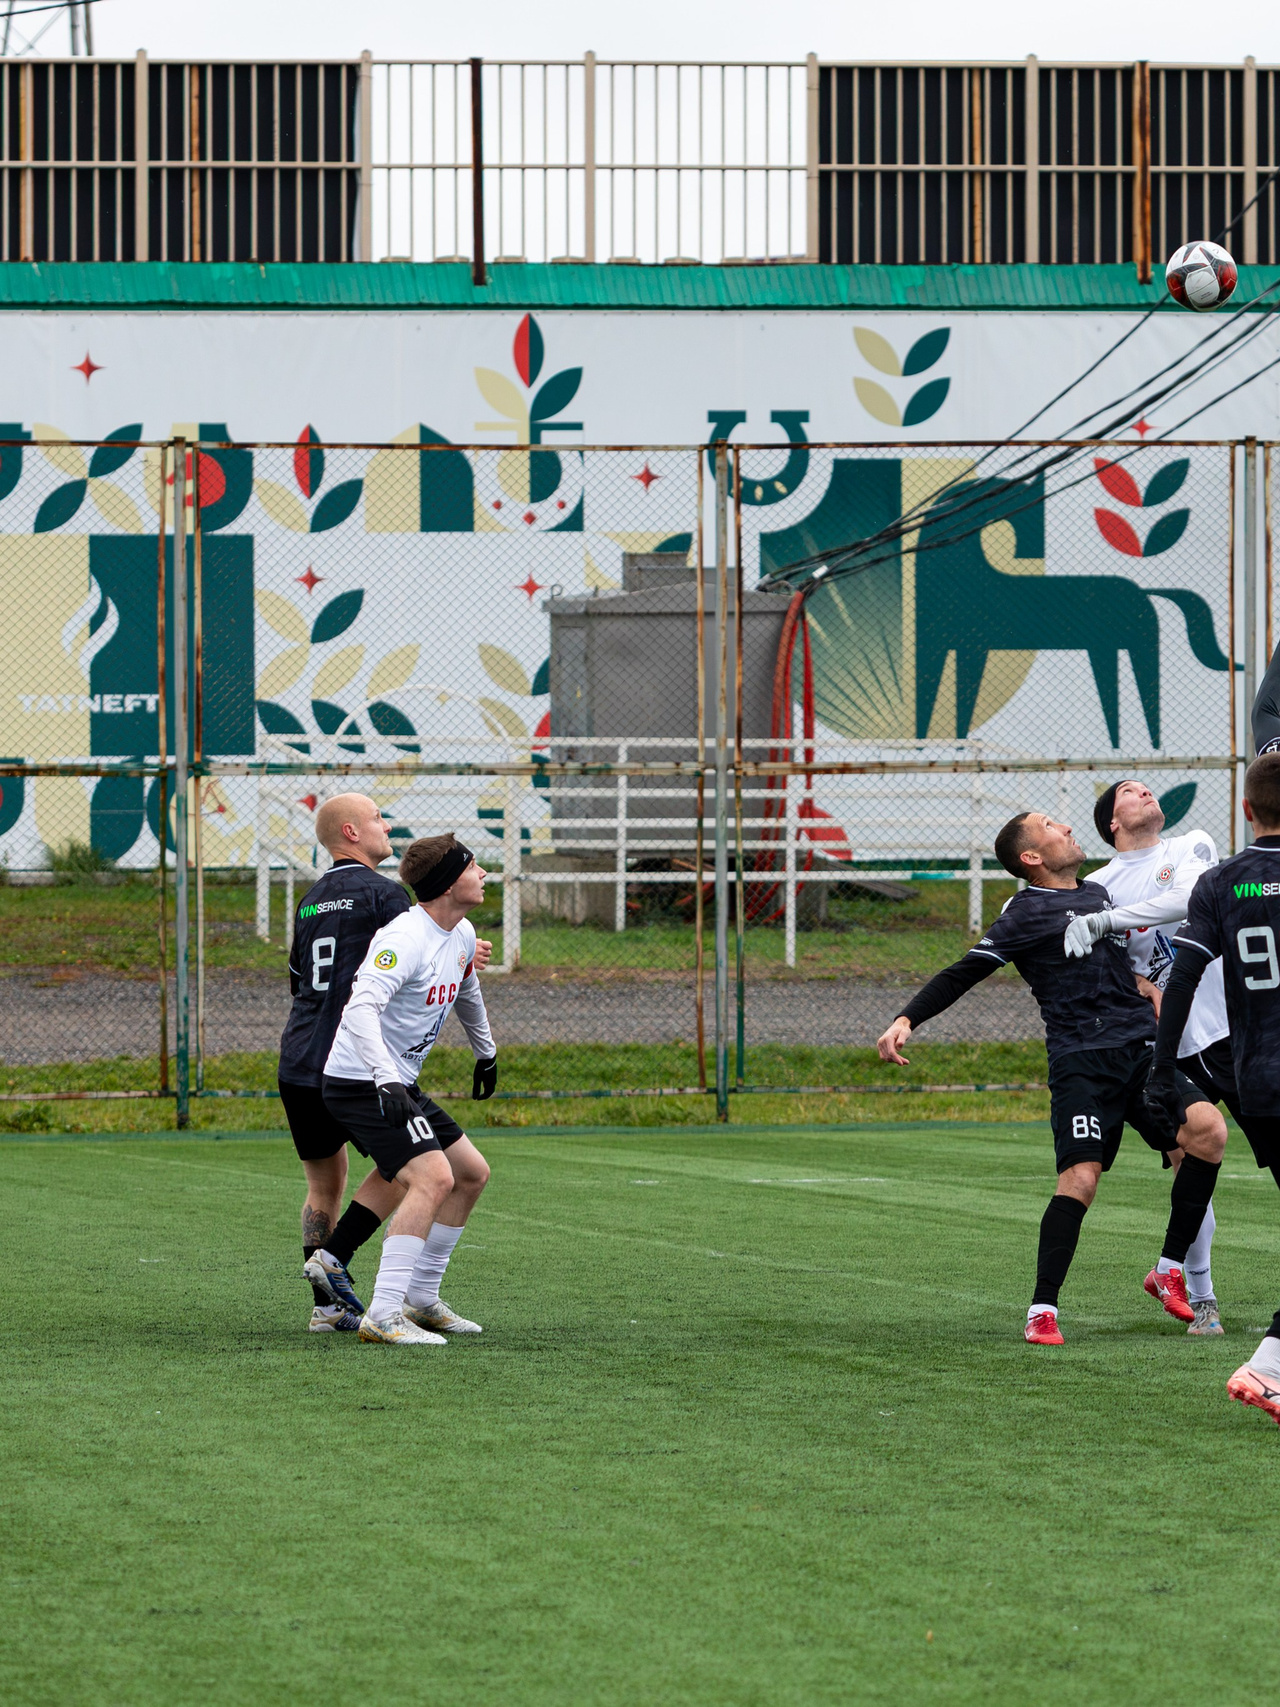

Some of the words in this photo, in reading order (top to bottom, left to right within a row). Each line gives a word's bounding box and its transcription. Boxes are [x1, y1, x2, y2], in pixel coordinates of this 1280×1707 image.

[16, 693, 160, 714] TATNEFT
[300, 898, 354, 919] VINSERVICE
[312, 936, 336, 992] 8
[425, 981, 463, 1006] ССС
[406, 1116, 434, 1144] 10
[1072, 1115, 1102, 1140] 85
